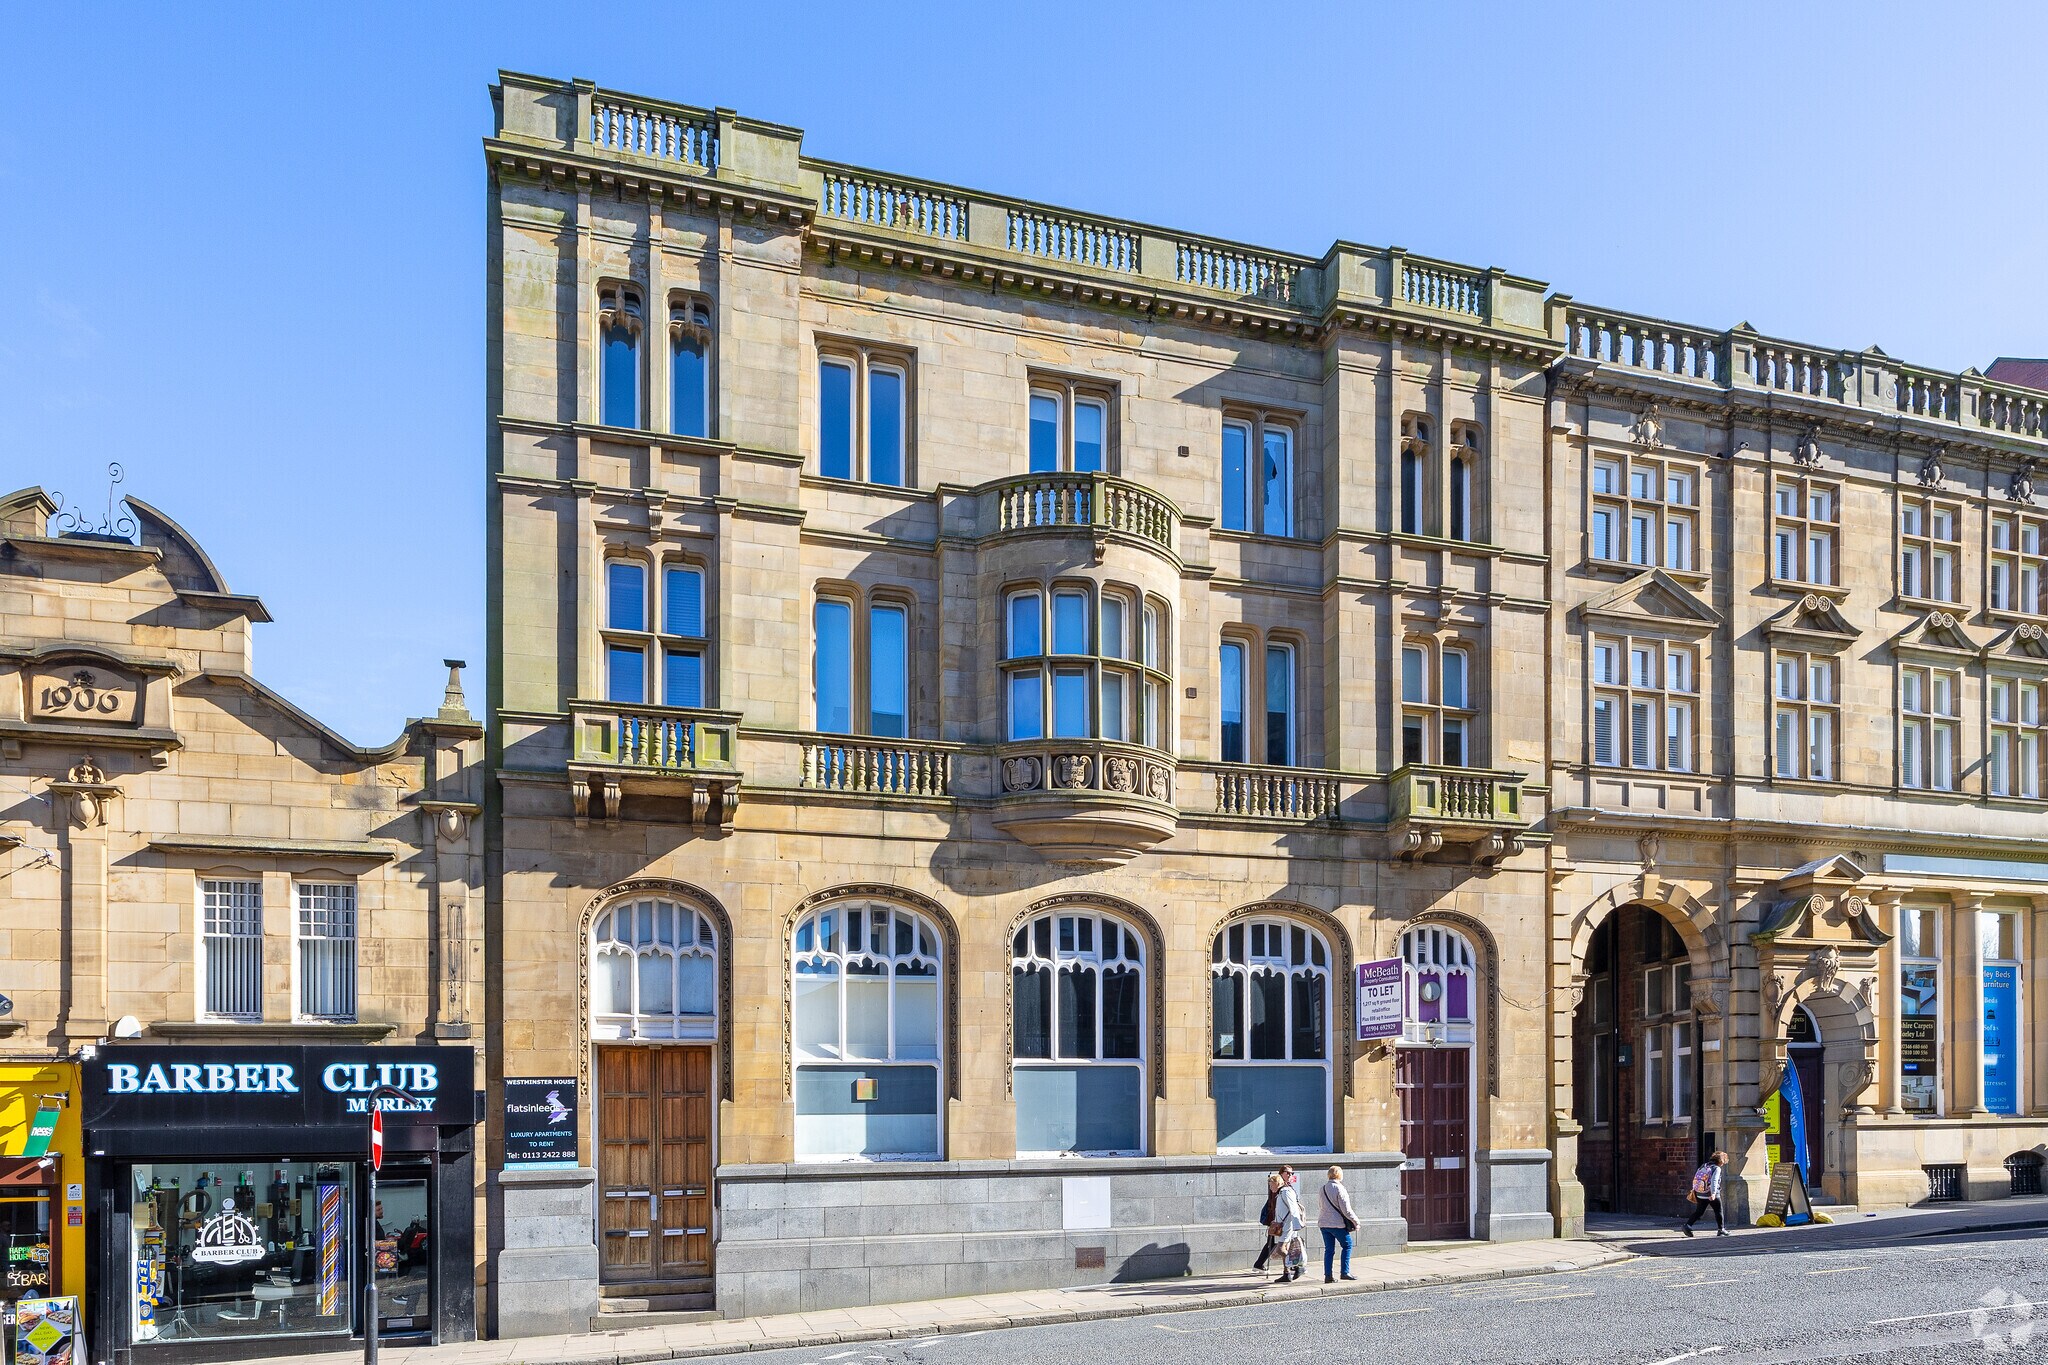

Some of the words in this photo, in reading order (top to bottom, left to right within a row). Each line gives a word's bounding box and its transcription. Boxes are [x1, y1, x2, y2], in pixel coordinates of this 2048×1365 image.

[42, 686, 122, 713] 1906
[1364, 964, 1399, 979] McBeath
[1995, 970, 2011, 979] Beds
[1983, 980, 2010, 989] urniture
[1368, 987, 1378, 998] TO
[1380, 985, 1394, 997] LET
[1984, 996, 1998, 1004] Beds
[1913, 1022, 1934, 1030] Carpets
[1915, 1030, 1925, 1038] Ltd
[107, 1063, 299, 1093] BARBER
[321, 1062, 439, 1093] CLUB
[507, 1103, 561, 1113] flatsinleeds
[9, 1253, 28, 1261] HOUR
[21, 1273, 48, 1286] BAR
